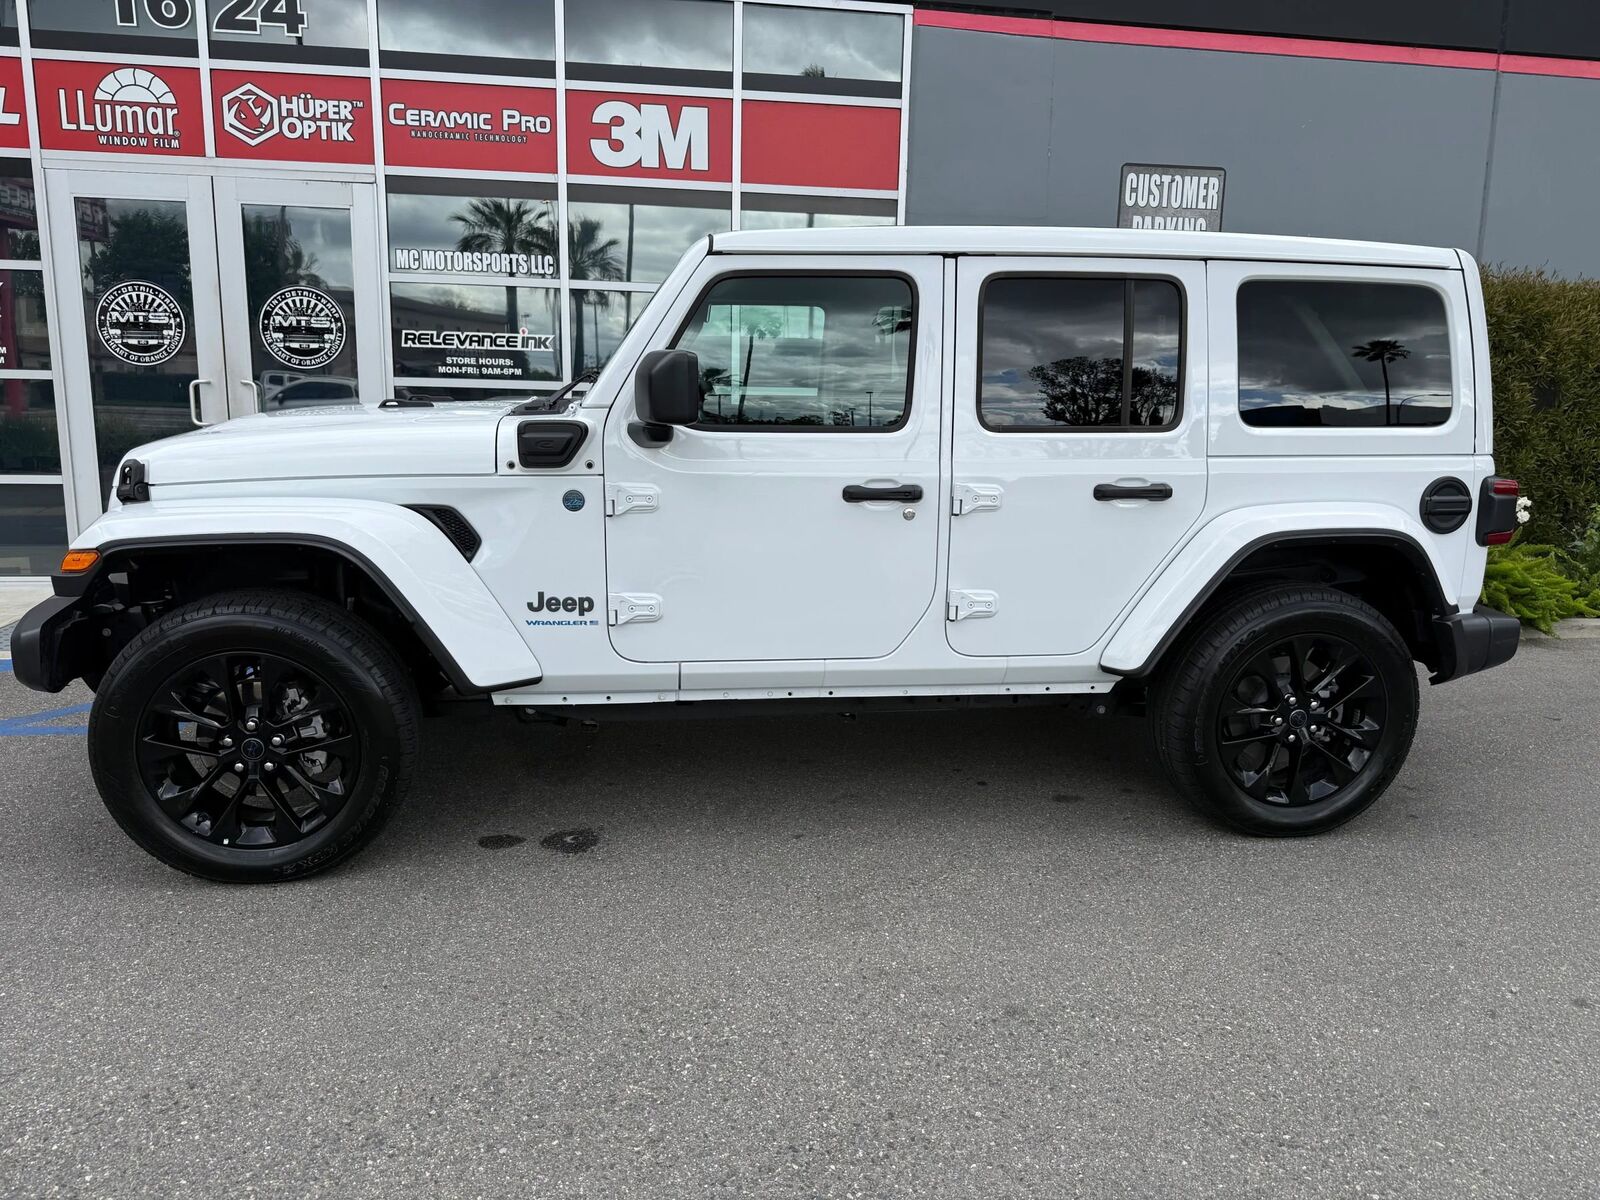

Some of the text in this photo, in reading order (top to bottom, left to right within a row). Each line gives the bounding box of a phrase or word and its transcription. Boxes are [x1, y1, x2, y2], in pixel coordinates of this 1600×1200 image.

[281, 117, 354, 142] OPTIK
[410, 130, 528, 143] NANOCERAMIC TECHNOLOGY
[590, 100, 709, 171] 3M
[97, 135, 180, 149] WINDOW FILM
[1125, 172, 1220, 209] CUSTOMER
[396, 249, 554, 275] MC MOTORSPORTS LLC
[102, 291, 119, 308] TINT
[266, 295, 282, 312] TINT
[109, 311, 170, 324] MTS
[273, 315, 332, 328] MTS
[100, 326, 182, 363] THE HEART OF ORANGE COUNTY
[263, 330, 273, 344] THE
[270, 343, 291, 363] HEART
[301, 354, 329, 366] ORANGE
[327, 332, 343, 356] COUNTY
[403, 331, 518, 349] RELEVANCE
[479, 358, 513, 366] HOURS:
[438, 366, 522, 376] MON-FRI: 9AM-6PM
[526, 591, 594, 616] Jeep
